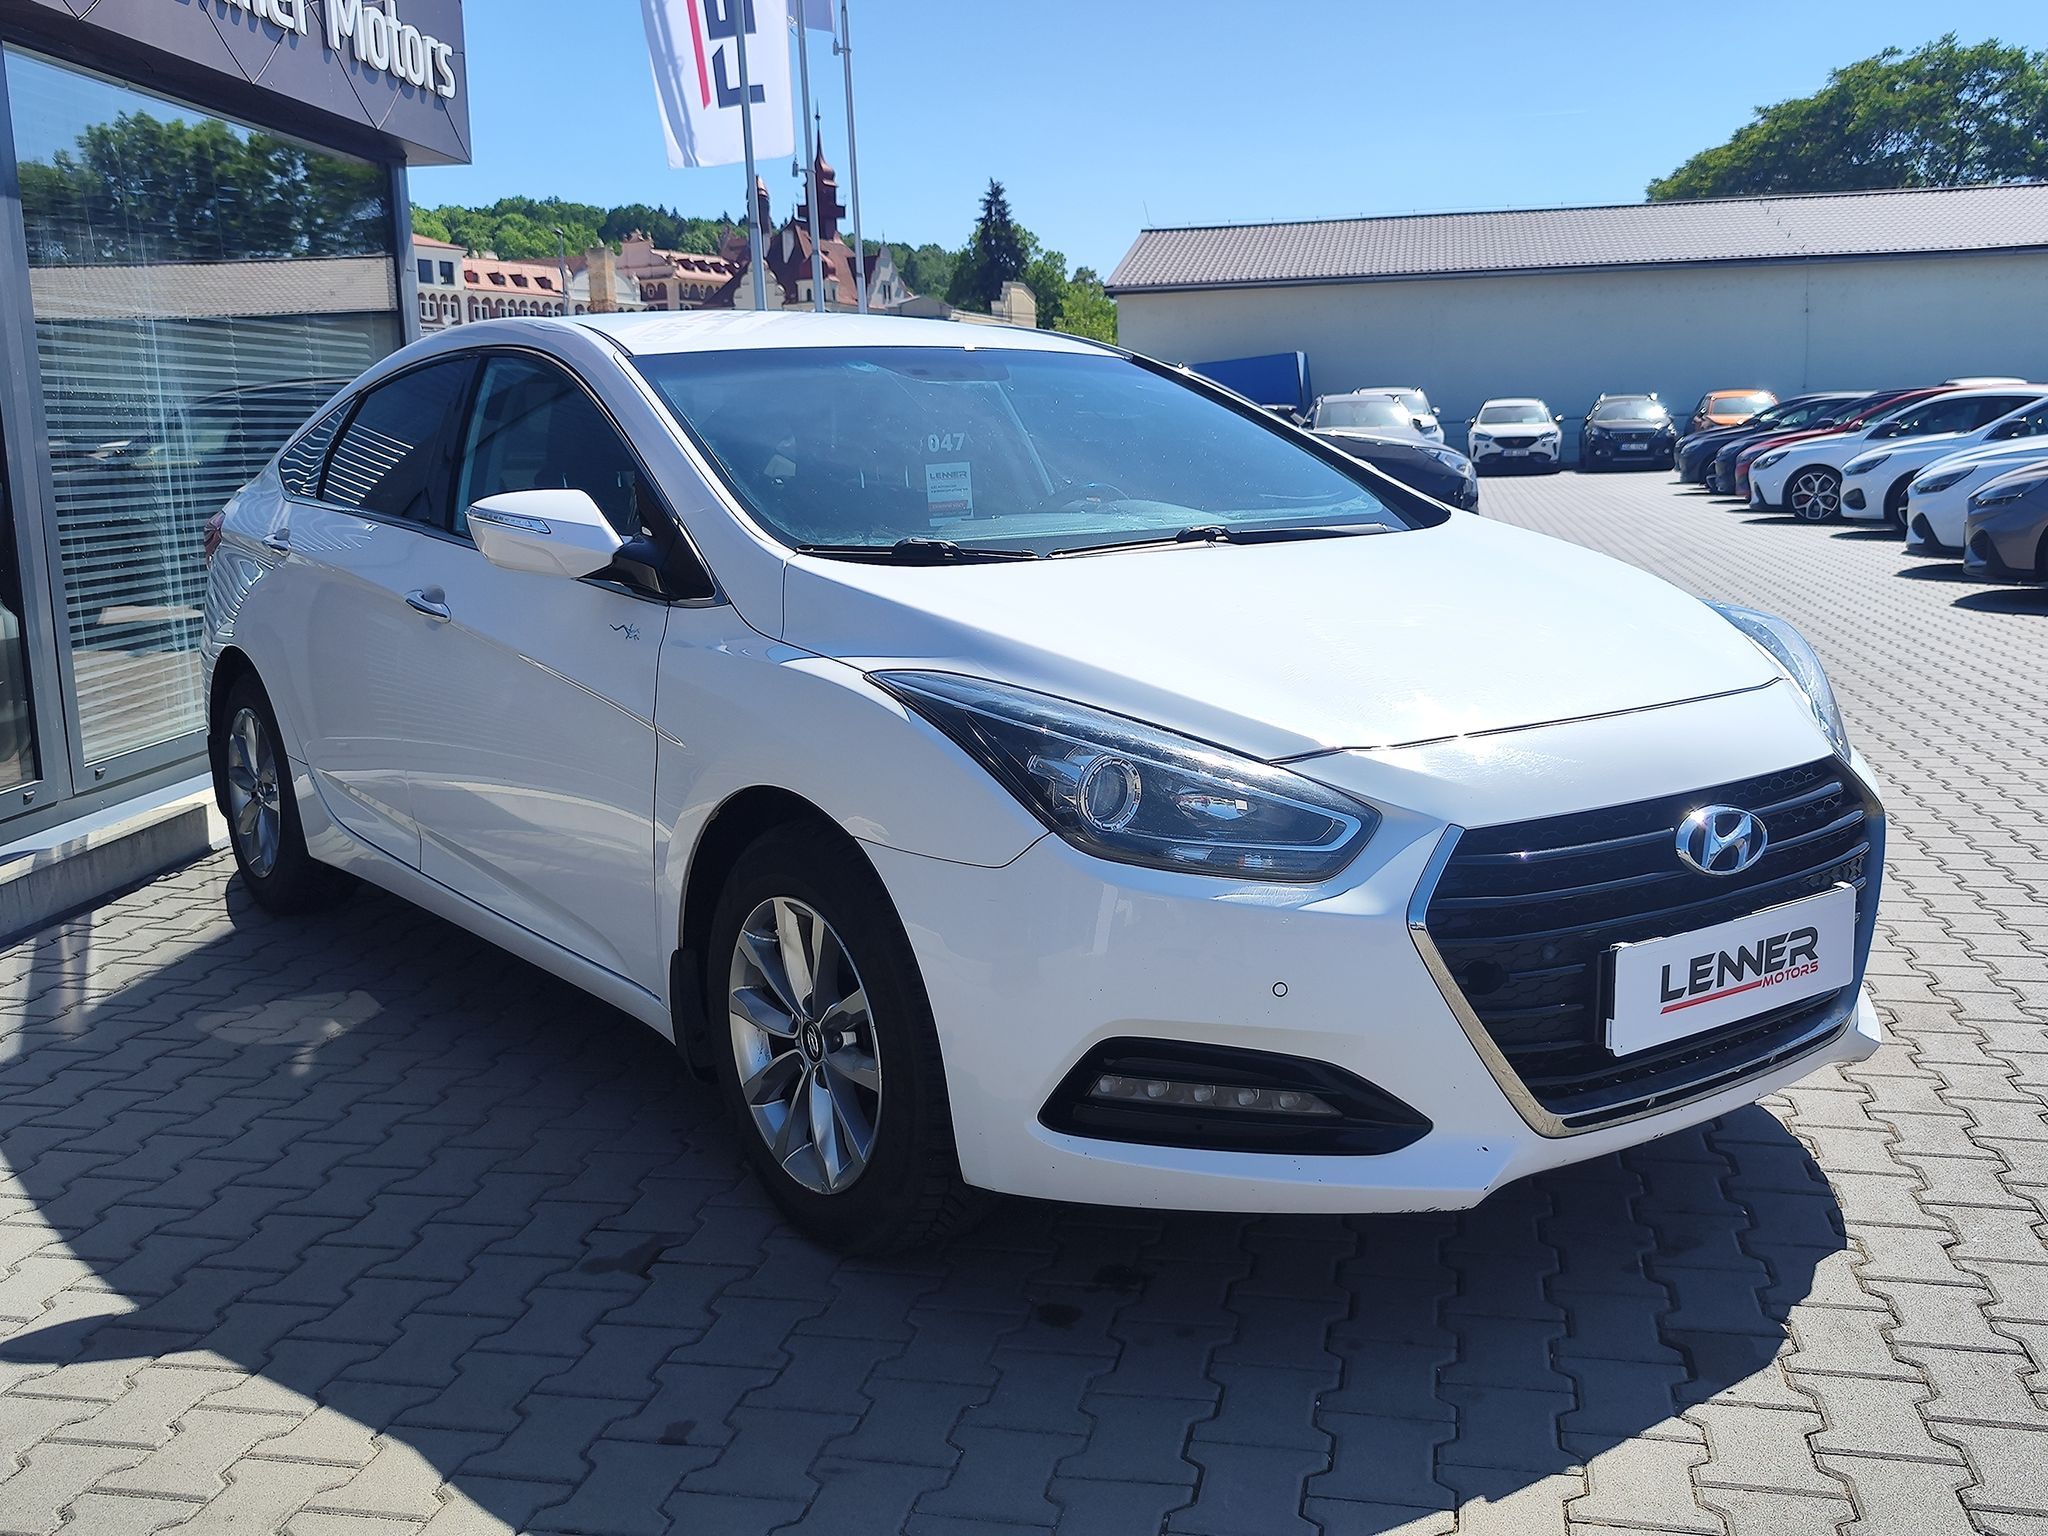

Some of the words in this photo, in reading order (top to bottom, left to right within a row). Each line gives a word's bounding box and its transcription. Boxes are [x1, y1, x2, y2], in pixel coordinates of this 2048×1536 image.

[323, 0, 456, 99] Motors
[927, 432, 965, 452] 047
[1660, 926, 1819, 1003] LENNER
[1761, 960, 1819, 988] MOTORS
